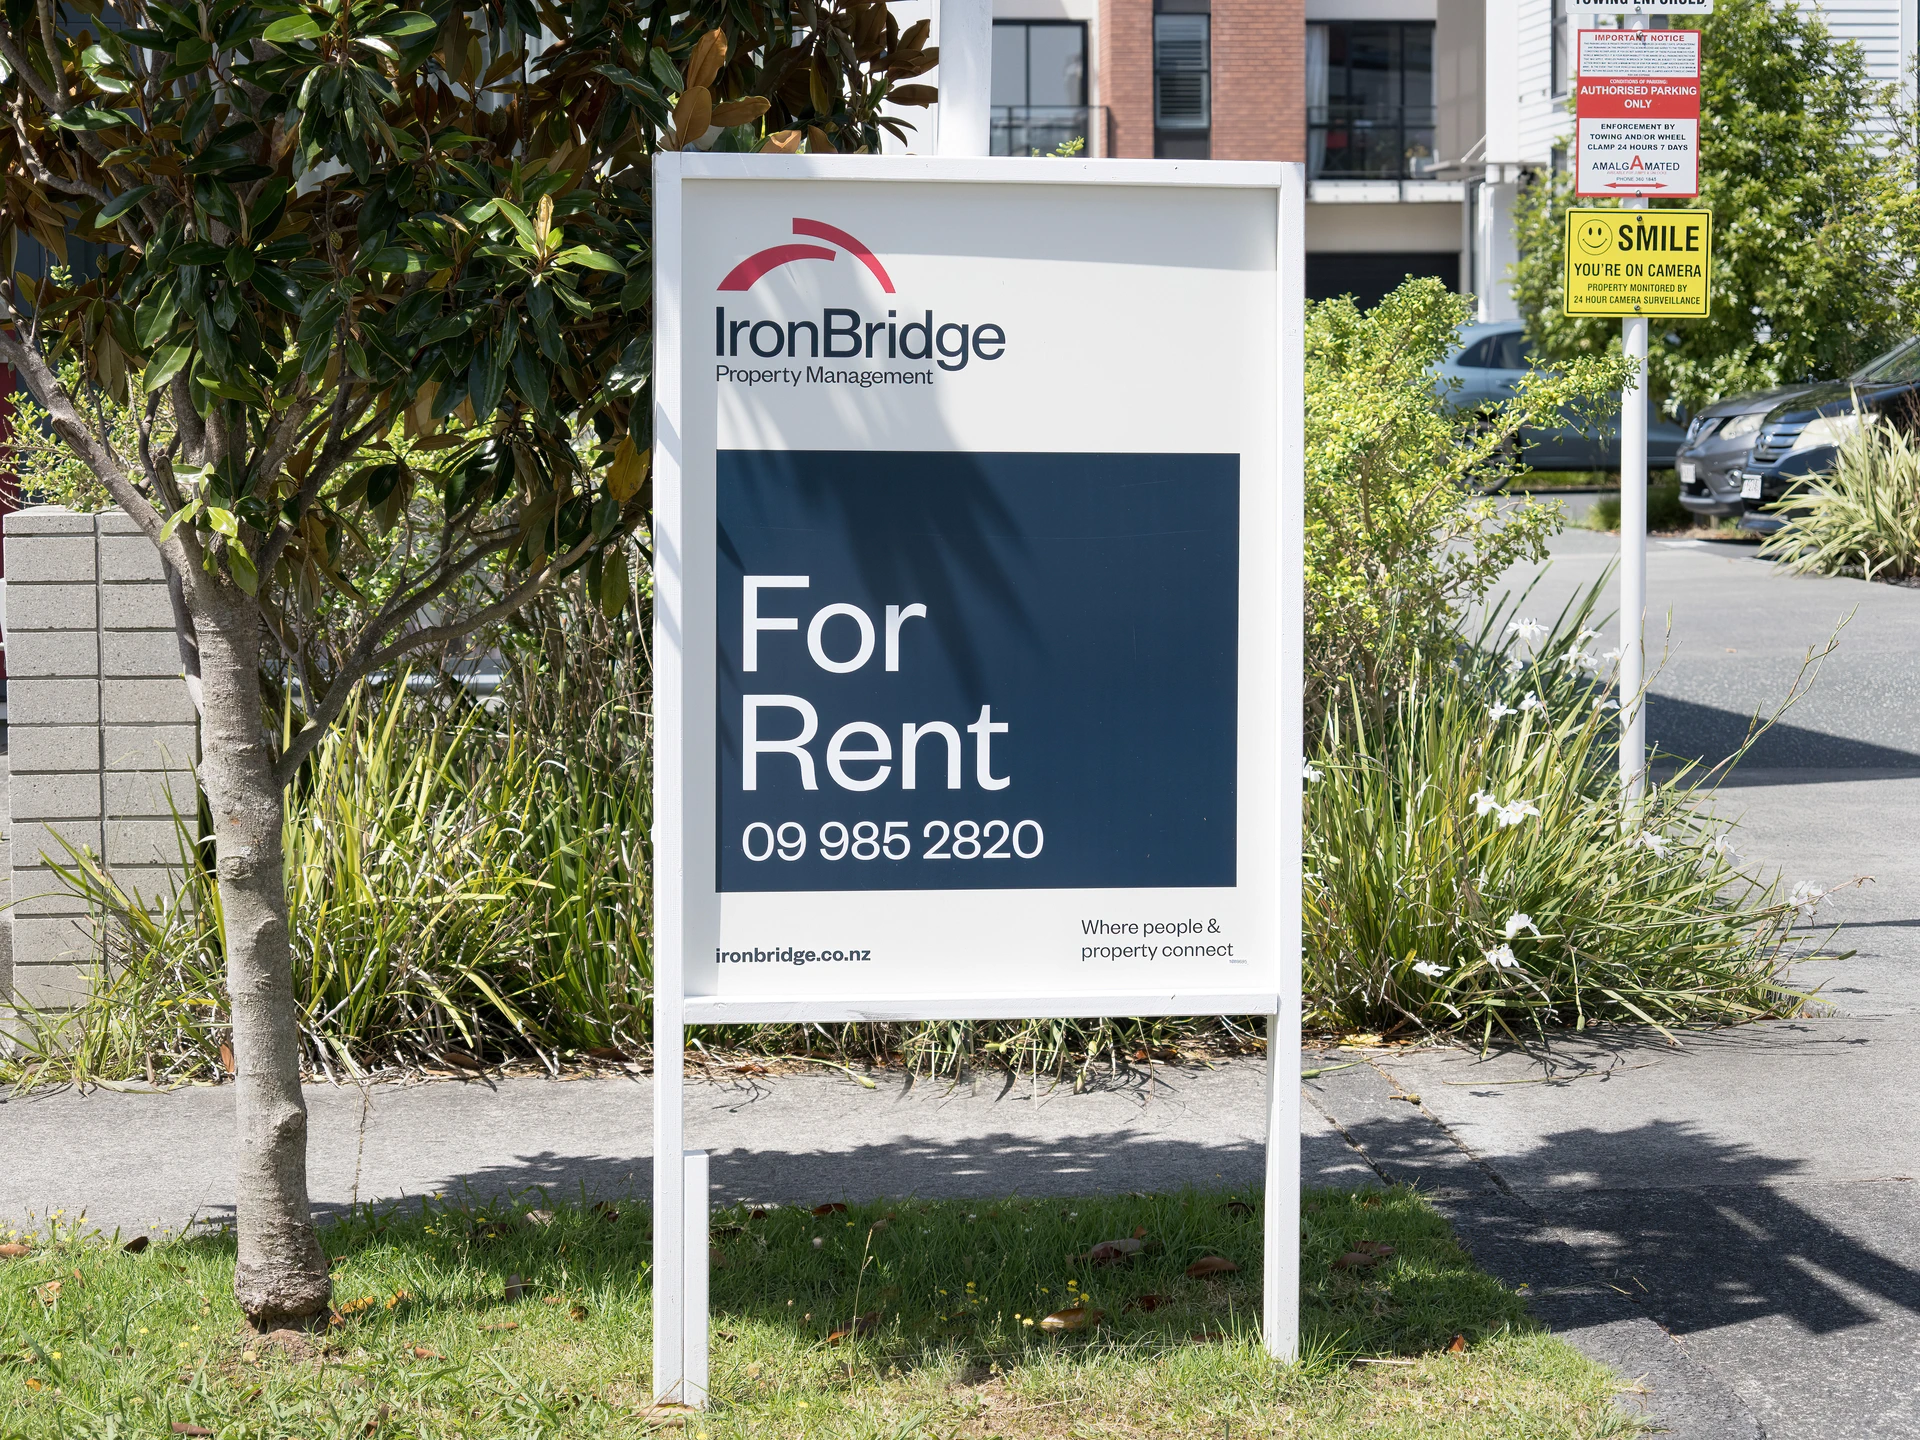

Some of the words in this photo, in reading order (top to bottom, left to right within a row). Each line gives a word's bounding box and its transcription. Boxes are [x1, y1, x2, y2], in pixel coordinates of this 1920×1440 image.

[1581, 86, 1648, 95] AUTHORISED
[1651, 86, 1696, 95] PARKING
[1624, 99, 1653, 109] ONLY
[1592, 155, 1680, 171] AMALGAMATED
[1619, 225, 1699, 251] SMILE
[1575, 263, 1620, 276] YOU'RE
[1626, 264, 1643, 276] ON
[1649, 264, 1701, 277] CAMERA
[1588, 284, 1628, 292] PROPERTY
[1630, 284, 1676, 293] MONITORED
[1678, 285, 1688, 293] BY
[1574, 296, 1583, 304] 24
[1586, 296, 1608, 304] HOUR
[1610, 296, 1642, 304] CAMERA
[1644, 296, 1701, 305] SURVEILLANCE
[716, 306, 1005, 371] IronBridge
[717, 365, 801, 386] Property
[807, 366, 933, 388] Management
[743, 576, 927, 673] For
[743, 695, 1010, 791] Rent
[743, 822, 806, 861] 09
[820, 821, 910, 860] 985
[923, 820, 1043, 859] 2820
[1082, 920, 1138, 934] Where
[1144, 919, 1202, 937] people
[1208, 918, 1220, 933] &
[716, 947, 870, 965] ironbridge.co.nz
[1082, 944, 1157, 961] property
[1162, 944, 1233, 957] connect
